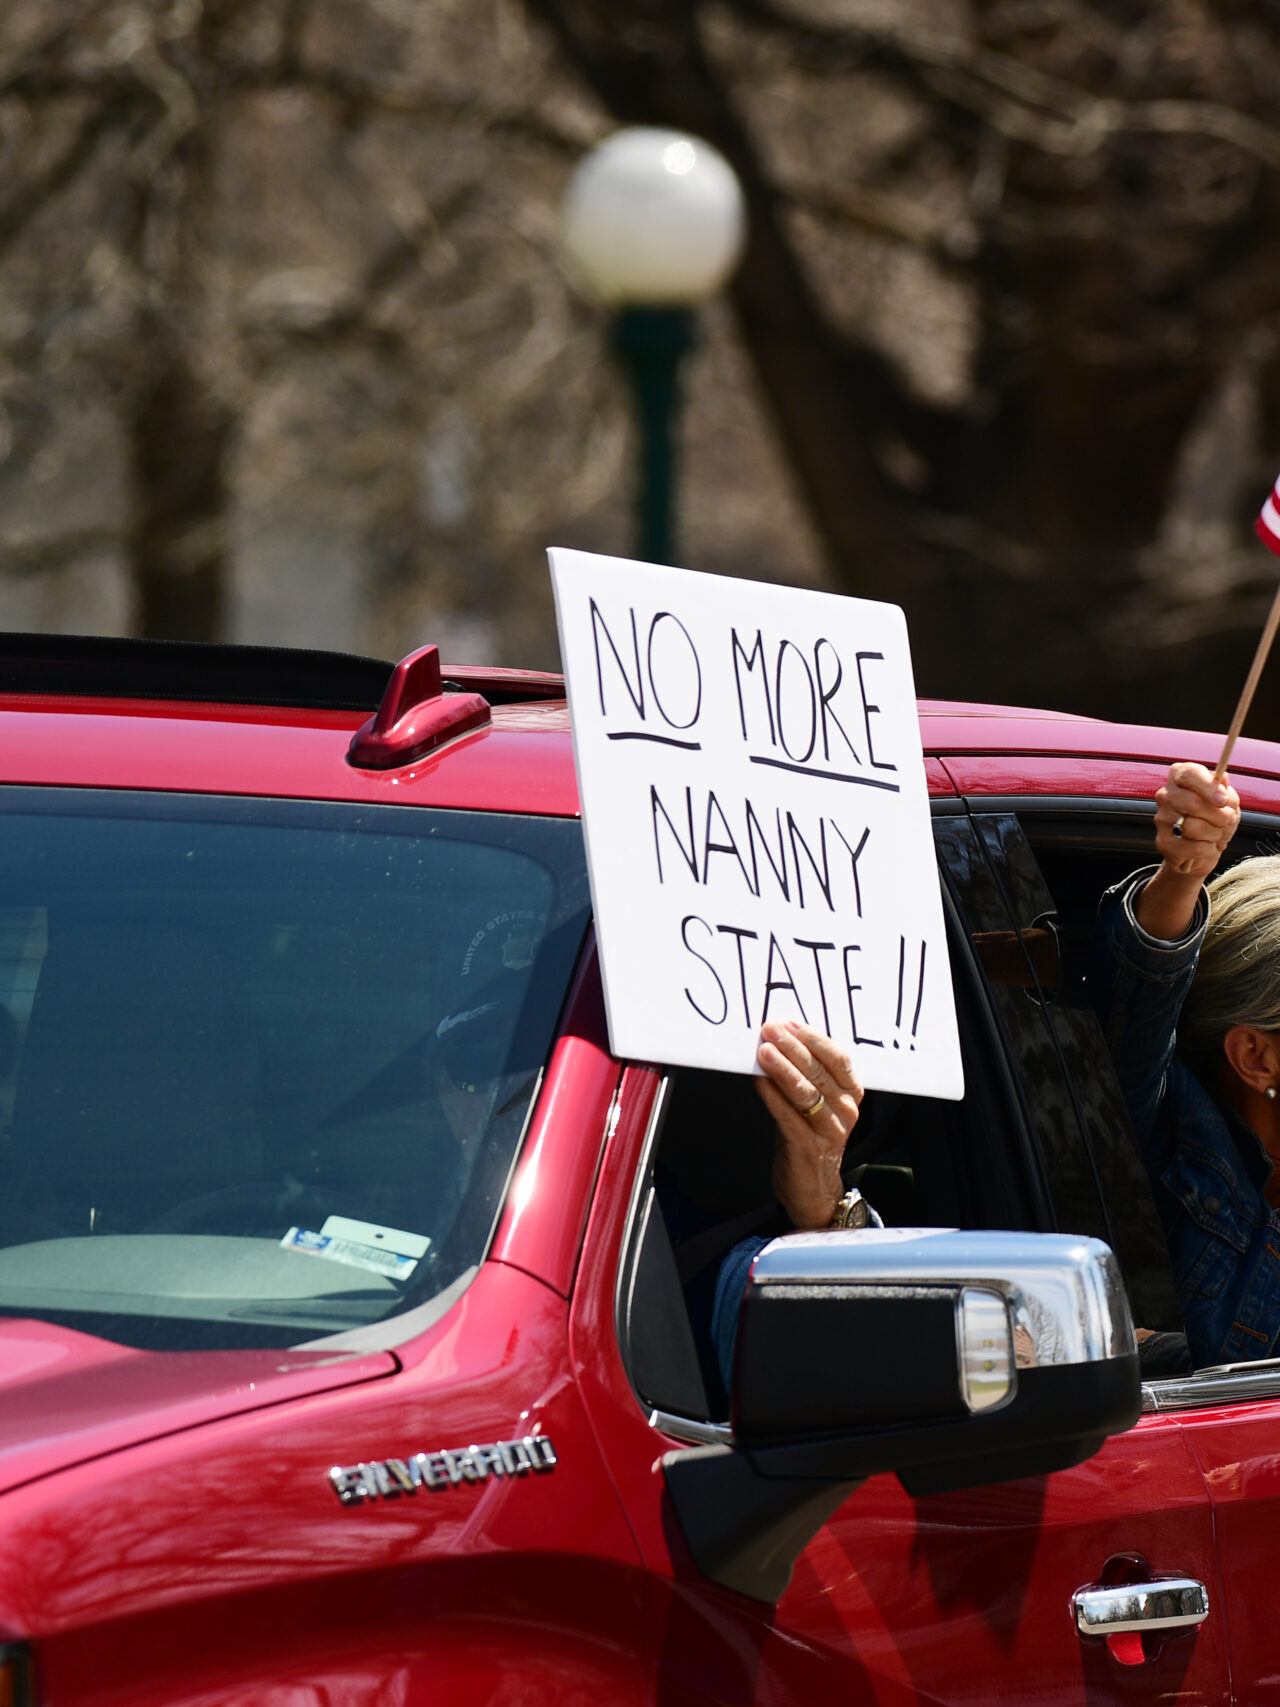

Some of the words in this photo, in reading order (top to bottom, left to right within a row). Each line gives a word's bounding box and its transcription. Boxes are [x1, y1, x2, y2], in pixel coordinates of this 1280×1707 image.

[589, 597, 701, 729] NO
[730, 627, 898, 771] MORE
[650, 784, 871, 918] NANNY
[460, 930, 485, 977] UNITED
[681, 915, 926, 1051] STATE!!
[330, 1435, 558, 1504] SILVERADO
